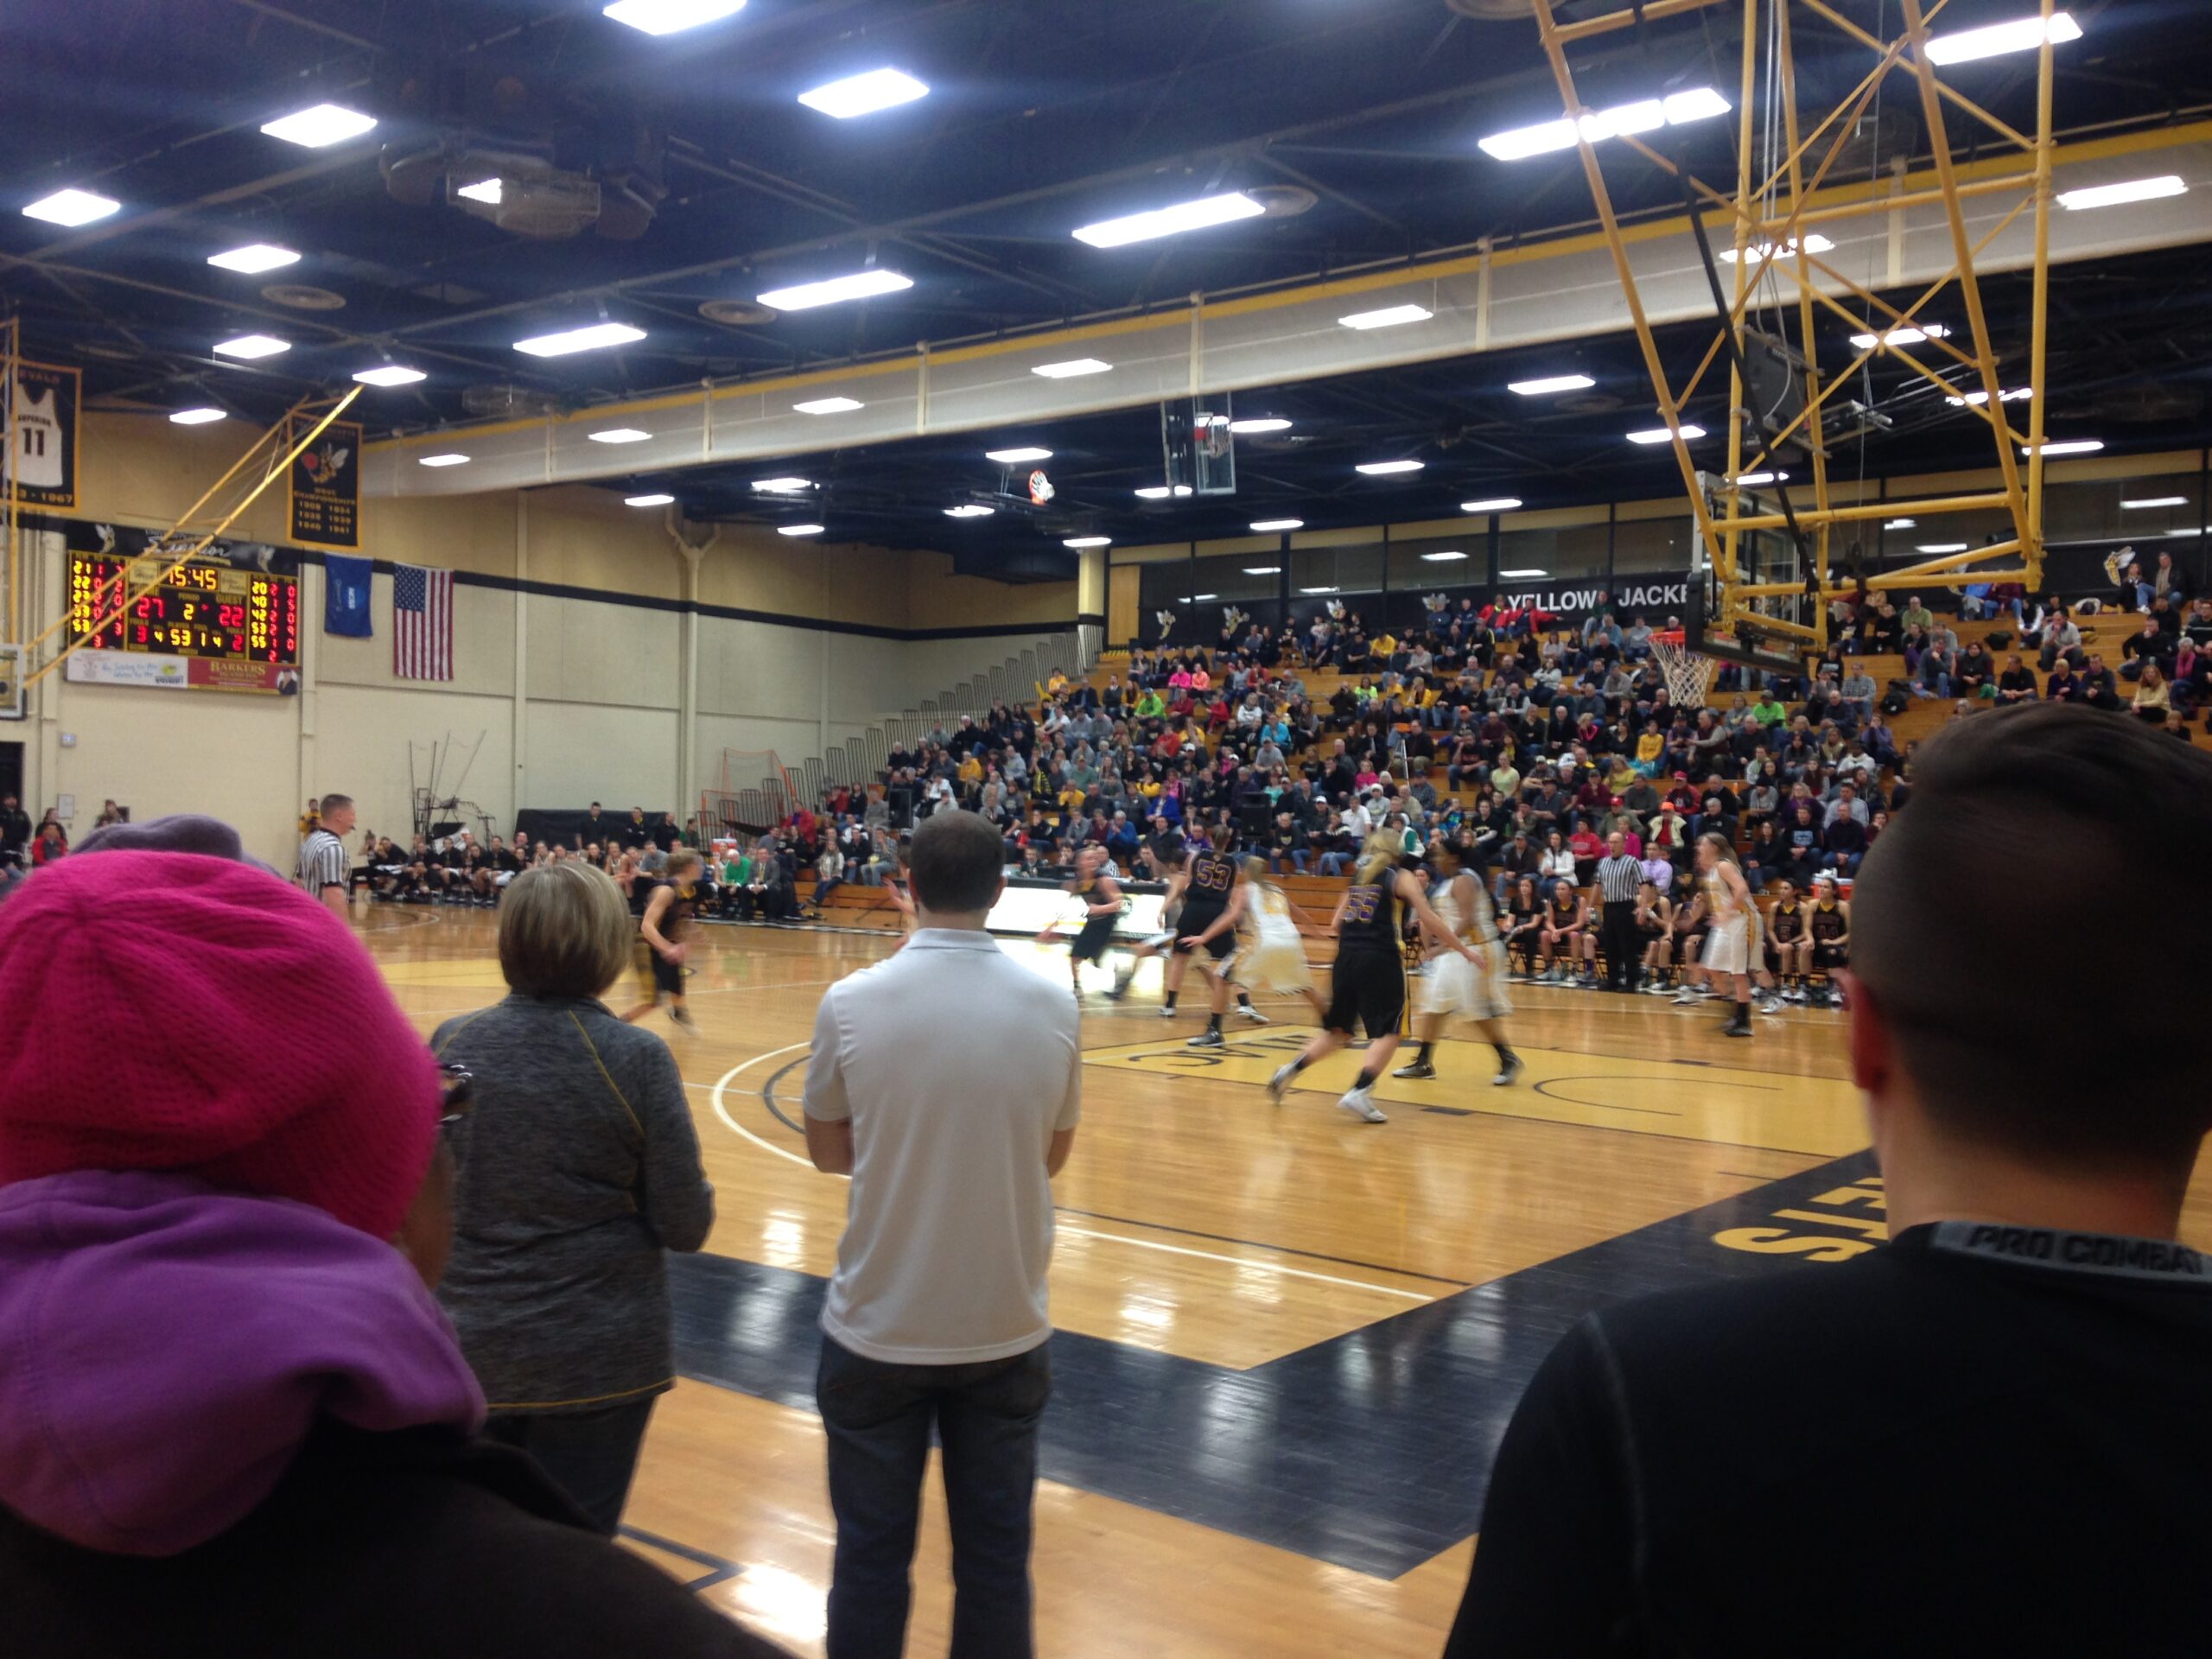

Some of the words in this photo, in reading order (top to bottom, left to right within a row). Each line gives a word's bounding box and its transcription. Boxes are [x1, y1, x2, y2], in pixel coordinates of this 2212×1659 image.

[22, 427, 44, 456] 11
[169, 565, 217, 590] 15:45
[137, 596, 165, 620] 27
[183, 603, 194, 620] 2
[219, 604, 245, 627] 22
[137, 625, 148, 643] 3
[170, 628, 191, 647] 53
[232, 633, 243, 652] 2
[1196, 859, 1232, 892] 53
[1966, 1225, 2055, 1259] PRO
